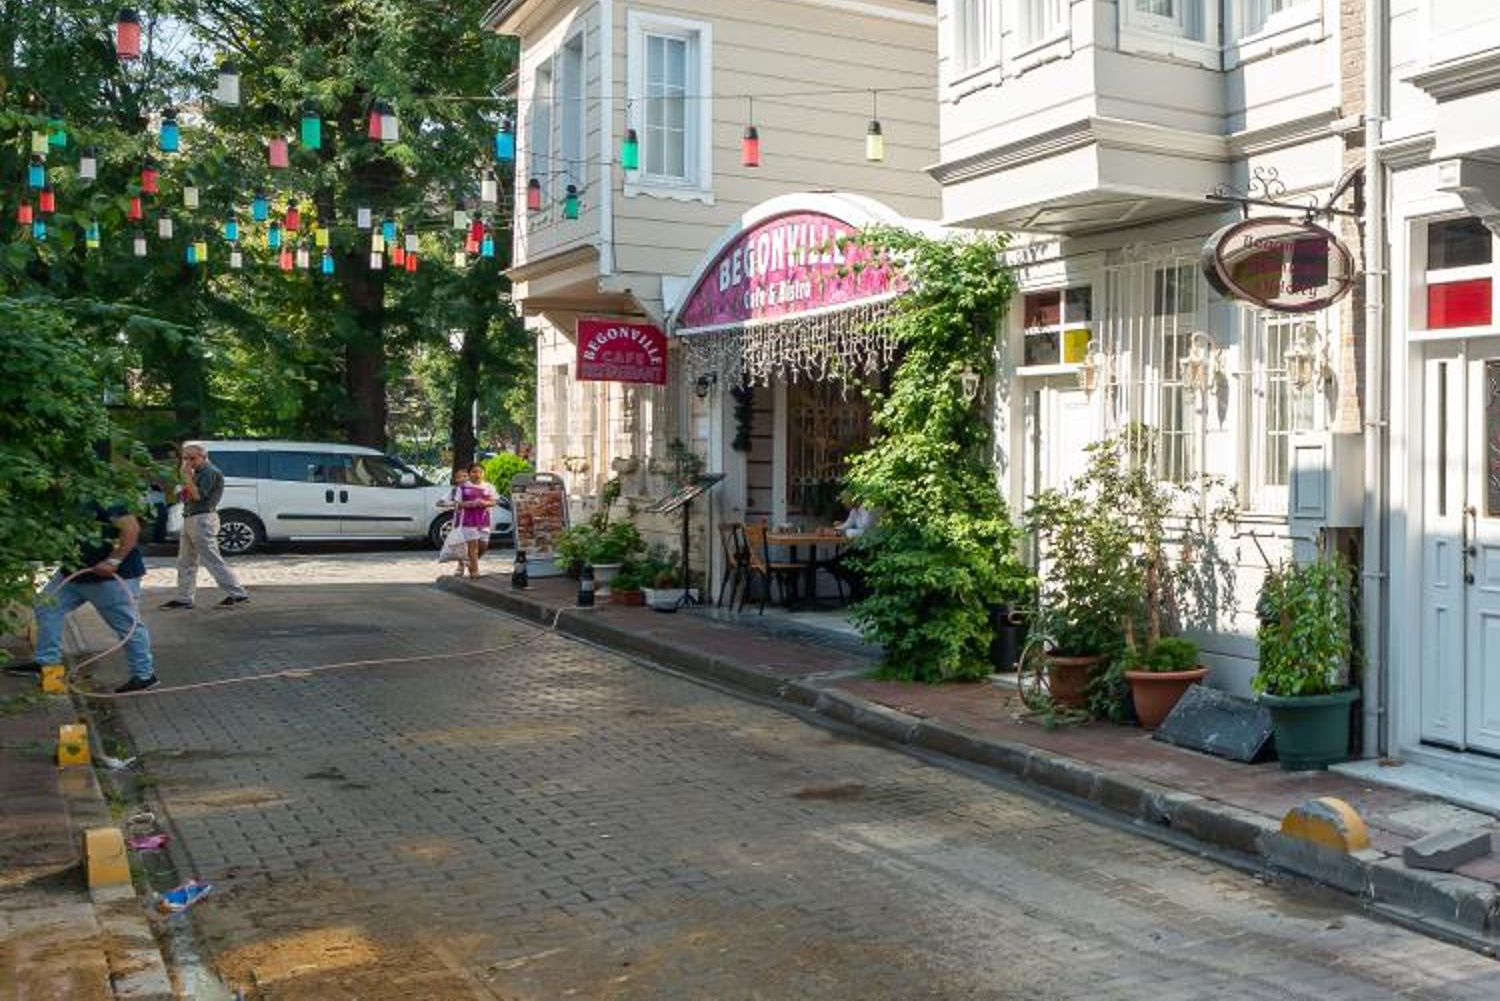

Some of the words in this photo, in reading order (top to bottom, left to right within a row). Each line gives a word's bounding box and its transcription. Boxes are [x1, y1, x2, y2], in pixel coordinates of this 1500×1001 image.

[719, 224, 846, 292] BEGONVILLE
[779, 279, 811, 304] Bistro
[584, 327, 663, 367] BEGONVILLE
